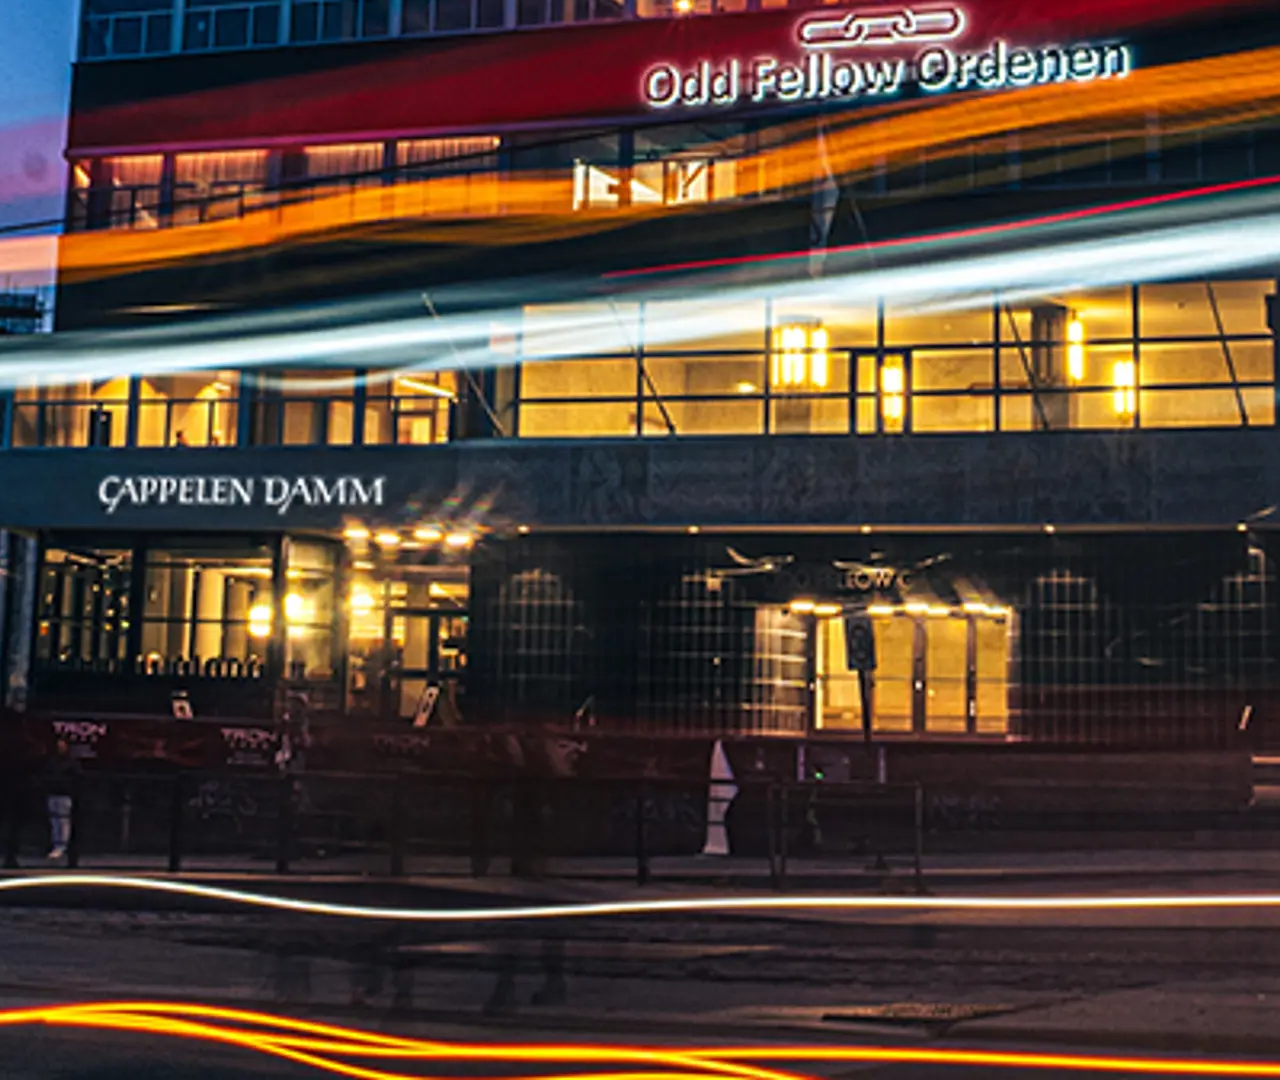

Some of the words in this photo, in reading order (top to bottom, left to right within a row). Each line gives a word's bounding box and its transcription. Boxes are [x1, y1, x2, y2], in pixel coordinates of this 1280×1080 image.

[644, 61, 738, 108] Odd
[750, 52, 906, 103] Fellow
[918, 42, 1131, 91] Ordenen
[98, 475, 255, 515] CAPPELEN
[262, 475, 387, 516] DAMM
